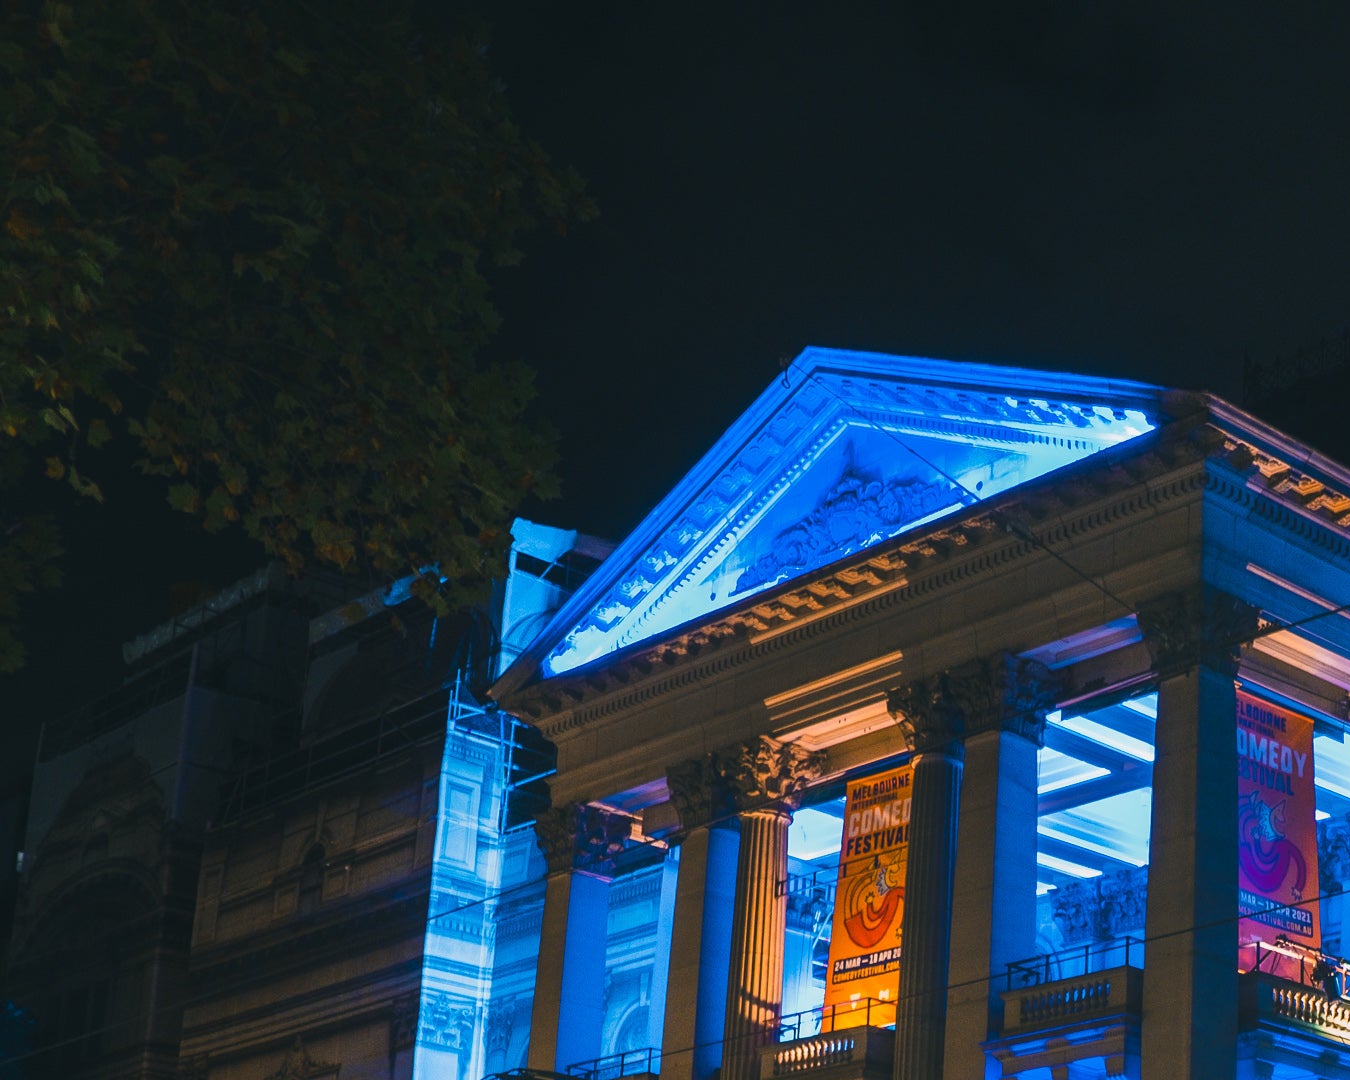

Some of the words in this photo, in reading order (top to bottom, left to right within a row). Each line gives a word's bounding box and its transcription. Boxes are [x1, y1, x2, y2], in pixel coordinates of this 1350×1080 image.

[852, 773, 910, 801] MELBOURNE
[1291, 909, 1312, 923] 2021
[835, 960, 844, 972] 24
[845, 956, 861, 969] MAR
[878, 949, 892, 962] APR
